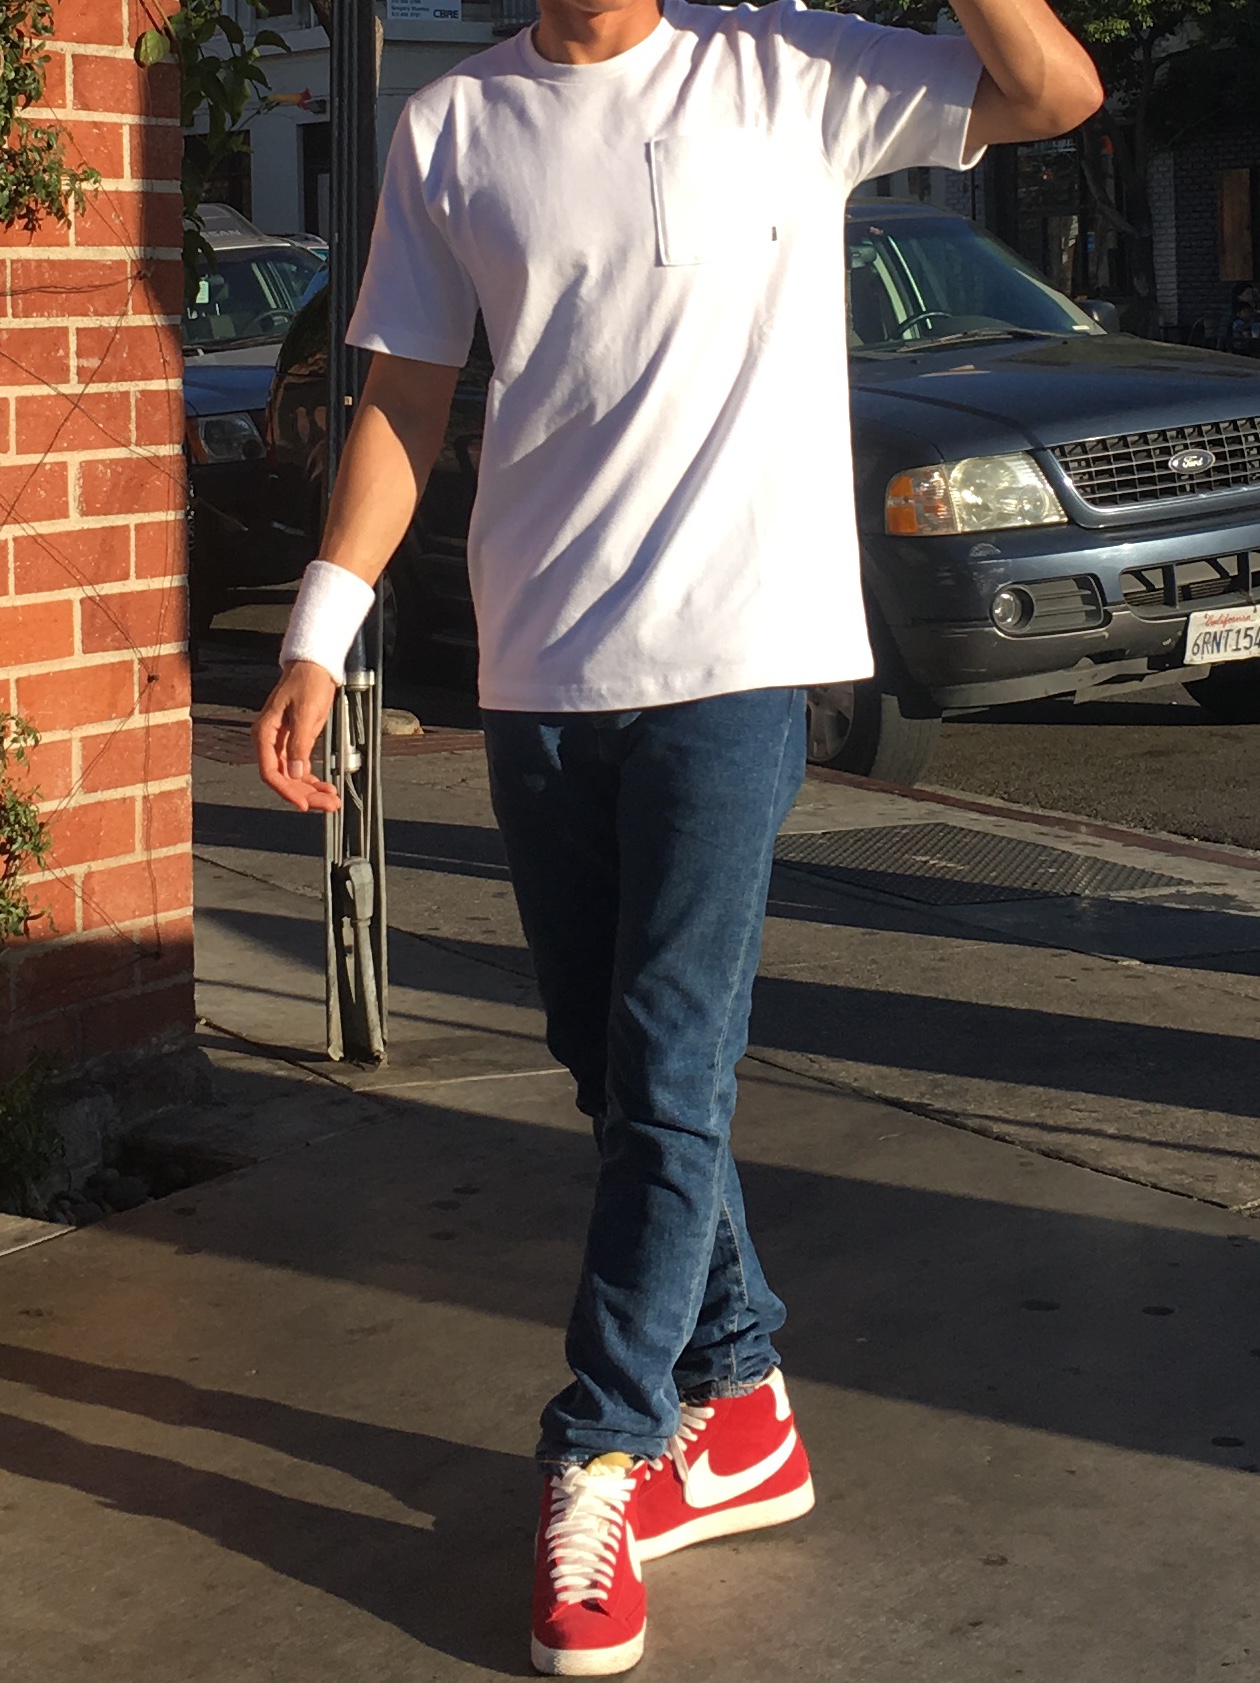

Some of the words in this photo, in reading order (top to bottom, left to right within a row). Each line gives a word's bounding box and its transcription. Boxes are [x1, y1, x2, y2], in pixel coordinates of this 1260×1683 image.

[433, 9, 459, 19] CBRE
[1182, 455, 1203, 468] Ford
[1204, 613, 1252, 627] California
